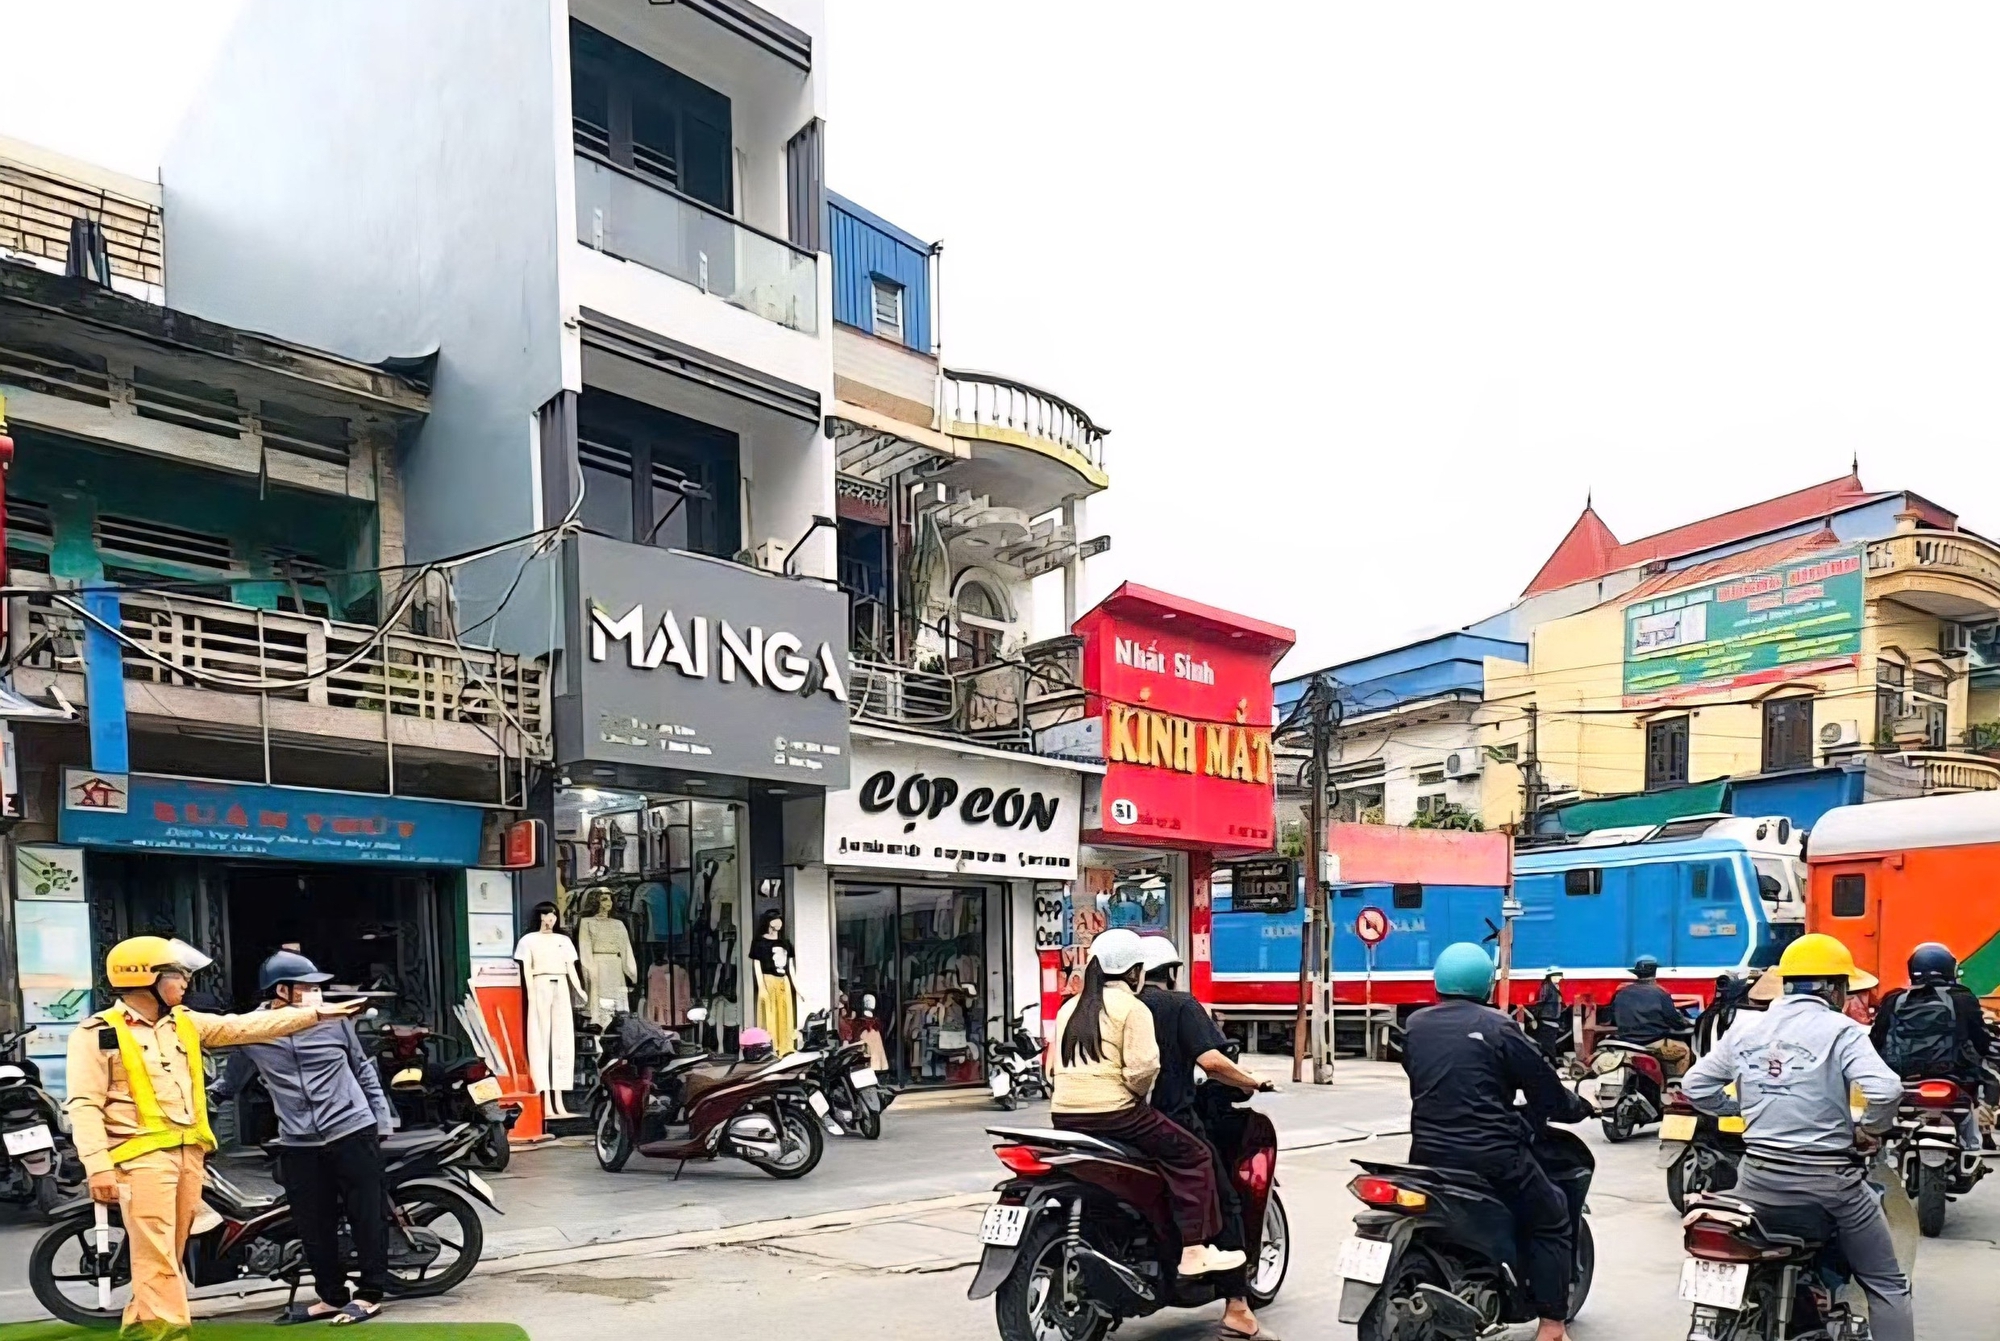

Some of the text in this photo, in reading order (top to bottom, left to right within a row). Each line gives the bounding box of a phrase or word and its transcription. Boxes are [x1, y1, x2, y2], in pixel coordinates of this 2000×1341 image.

[590, 602, 849, 702] MAI NGA
[1174, 652, 1215, 686] Sinh
[859, 770, 1060, 834] CỌP CON
[759, 878, 782, 898] 47
